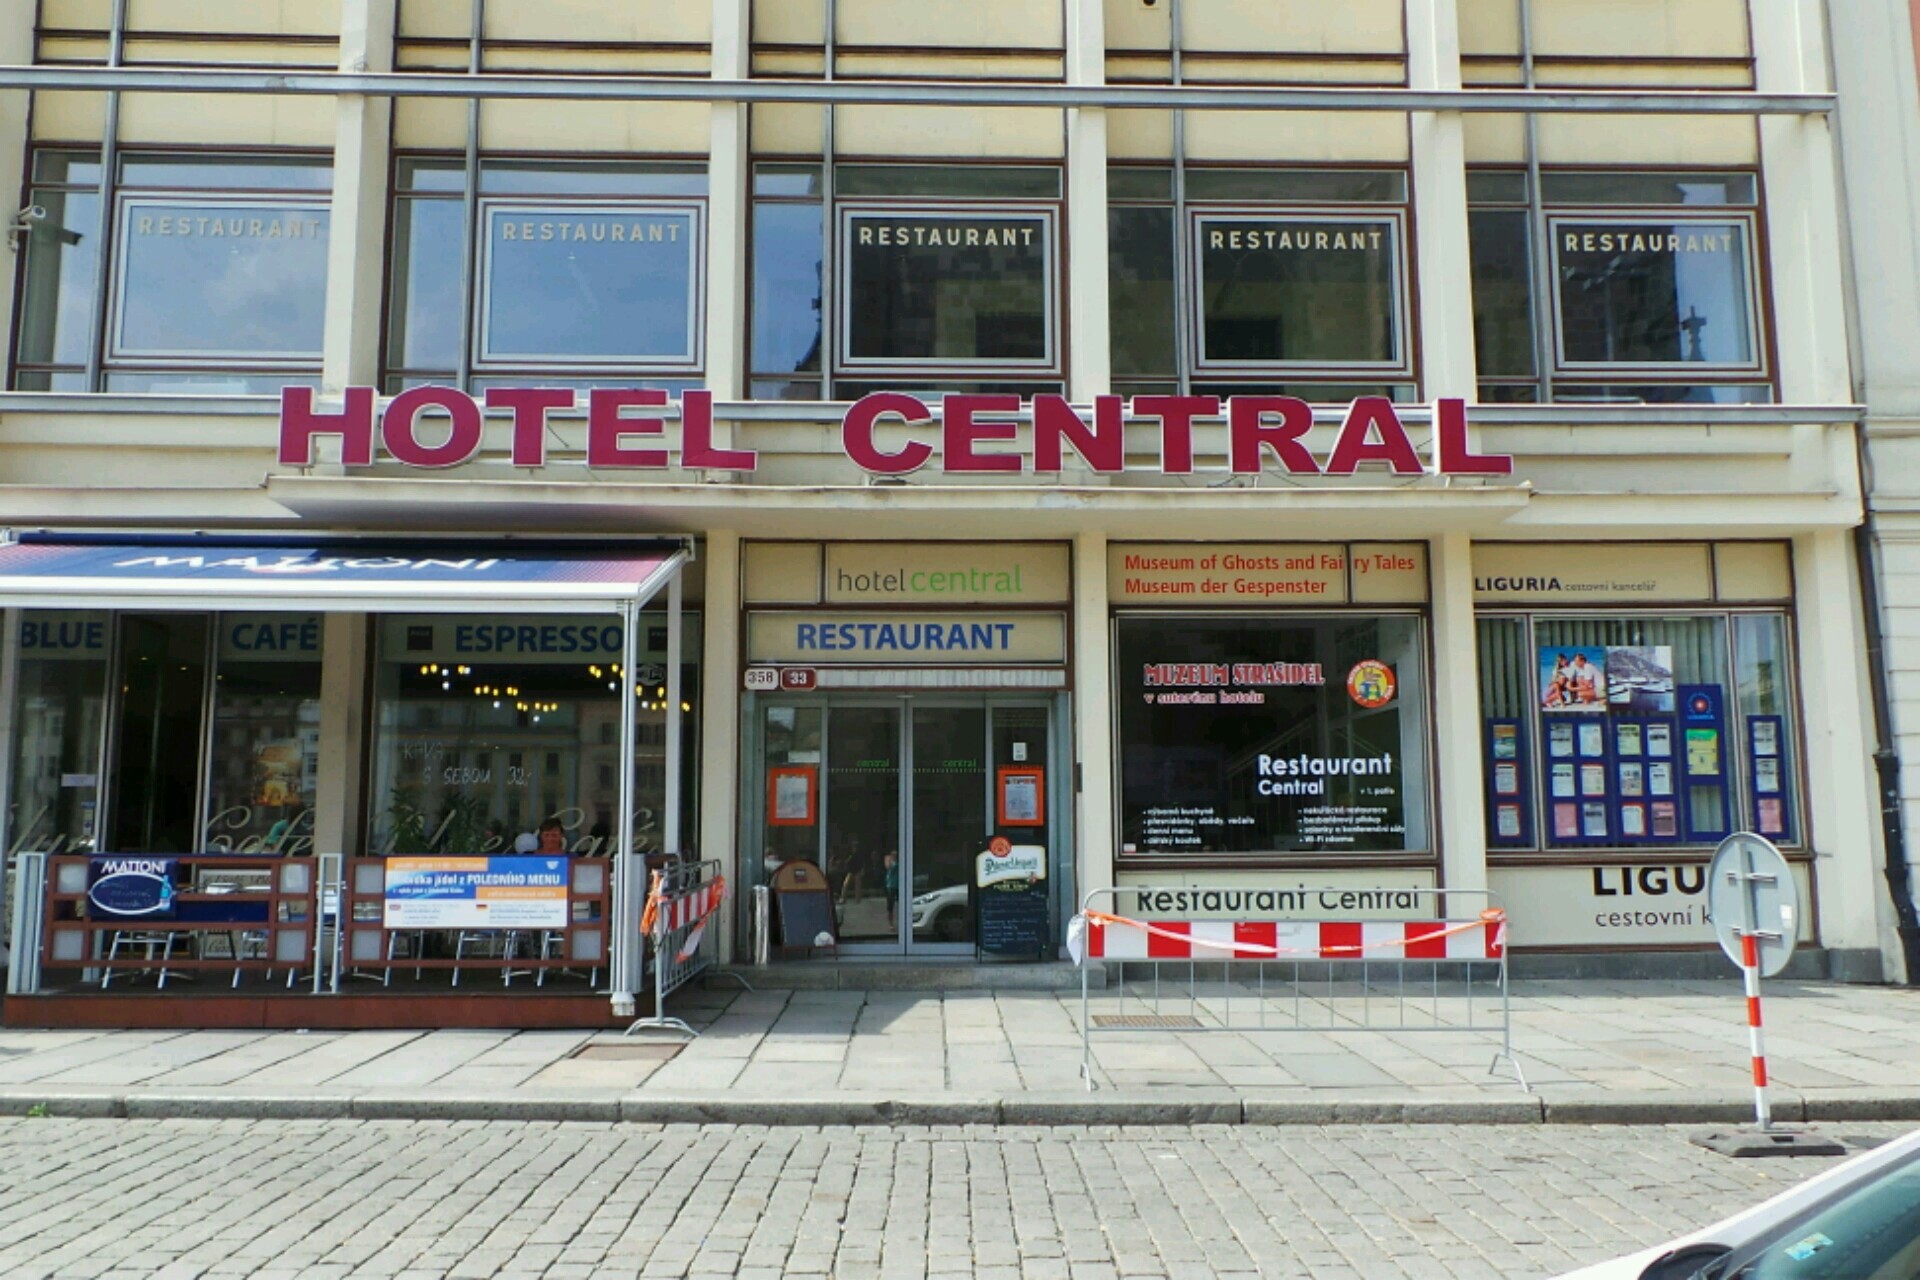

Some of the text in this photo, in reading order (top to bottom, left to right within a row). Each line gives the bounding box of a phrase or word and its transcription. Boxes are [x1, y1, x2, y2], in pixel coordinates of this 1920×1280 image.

[138, 215, 322, 239] RESTAURANT
[501, 221, 681, 243] RESTAURANT
[858, 226, 1035, 247] RESTAURANT
[1210, 229, 1381, 250] RESTAURANT
[1564, 233, 1733, 253] RESTAURANT
[278, 384, 1514, 477] HOTEL CENTRAL
[1125, 554, 1195, 571] Museum
[1200, 553, 1217, 571] of
[1223, 553, 1280, 571] Ghosts
[1285, 553, 1315, 571] and
[1374, 554, 1416, 571] Tales
[837, 564, 1023, 594] hotel central
[1125, 577, 1328, 598] Museum der Gespenster
[1474, 577, 1562, 592] LIGURIA
[21, 617, 319, 651] BLUE CAFÉ
[455, 624, 624, 653] ESPRESSO
[796, 623, 1015, 650] RESTAURANT
[748, 671, 773, 684] 358
[1143, 663, 1229, 686] MUZEUM
[1231, 661, 1325, 686] STRAŠIDEL
[1257, 752, 1393, 776] Restaurant
[1257, 778, 1325, 796] Central
[100, 859, 167, 875] MATTONI
[527, 873, 561, 886] MENU
[1592, 867, 1706, 896] LIGU
[1137, 884, 1420, 912] Restaurant Central
[1595, 905, 1692, 928] cestovní
